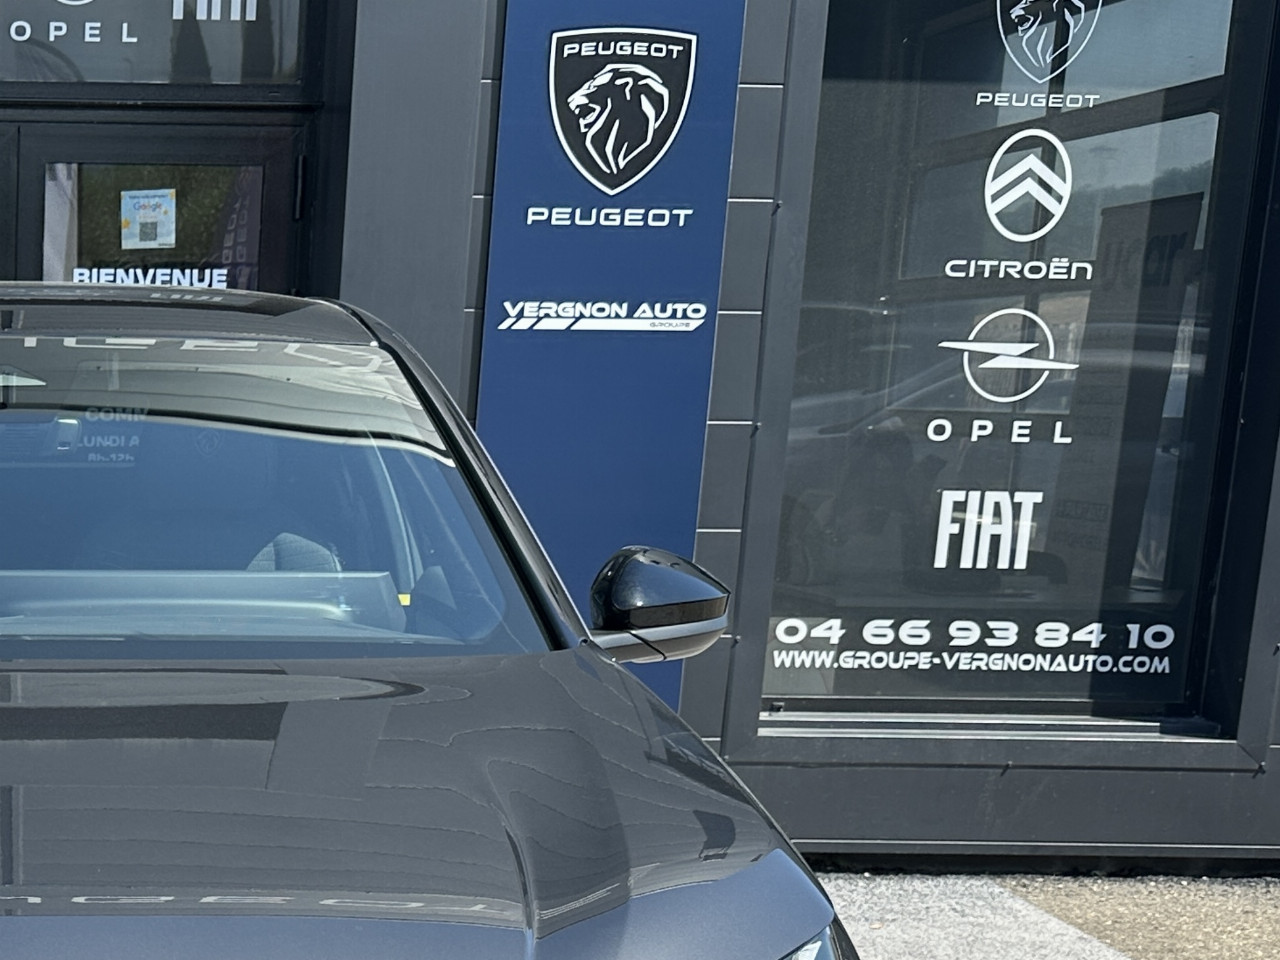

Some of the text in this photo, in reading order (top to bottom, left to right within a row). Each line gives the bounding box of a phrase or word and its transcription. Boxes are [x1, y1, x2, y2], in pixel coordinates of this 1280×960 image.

[9, 20, 138, 43] OPEL
[563, 41, 684, 59] PEUGEOT
[976, 92, 1101, 108] PEUGEOT
[526, 206, 694, 227] PEUGEOT
[503, 301, 707, 319] VERGNON AUTO
[927, 418, 1072, 444] OPEL
[933, 490, 1044, 570] FIAT
[775, 617, 1175, 650] 04 66 93 84 10
[772, 649, 1170, 674] WWW.GROUPE-VERGNONAUTO.COM
